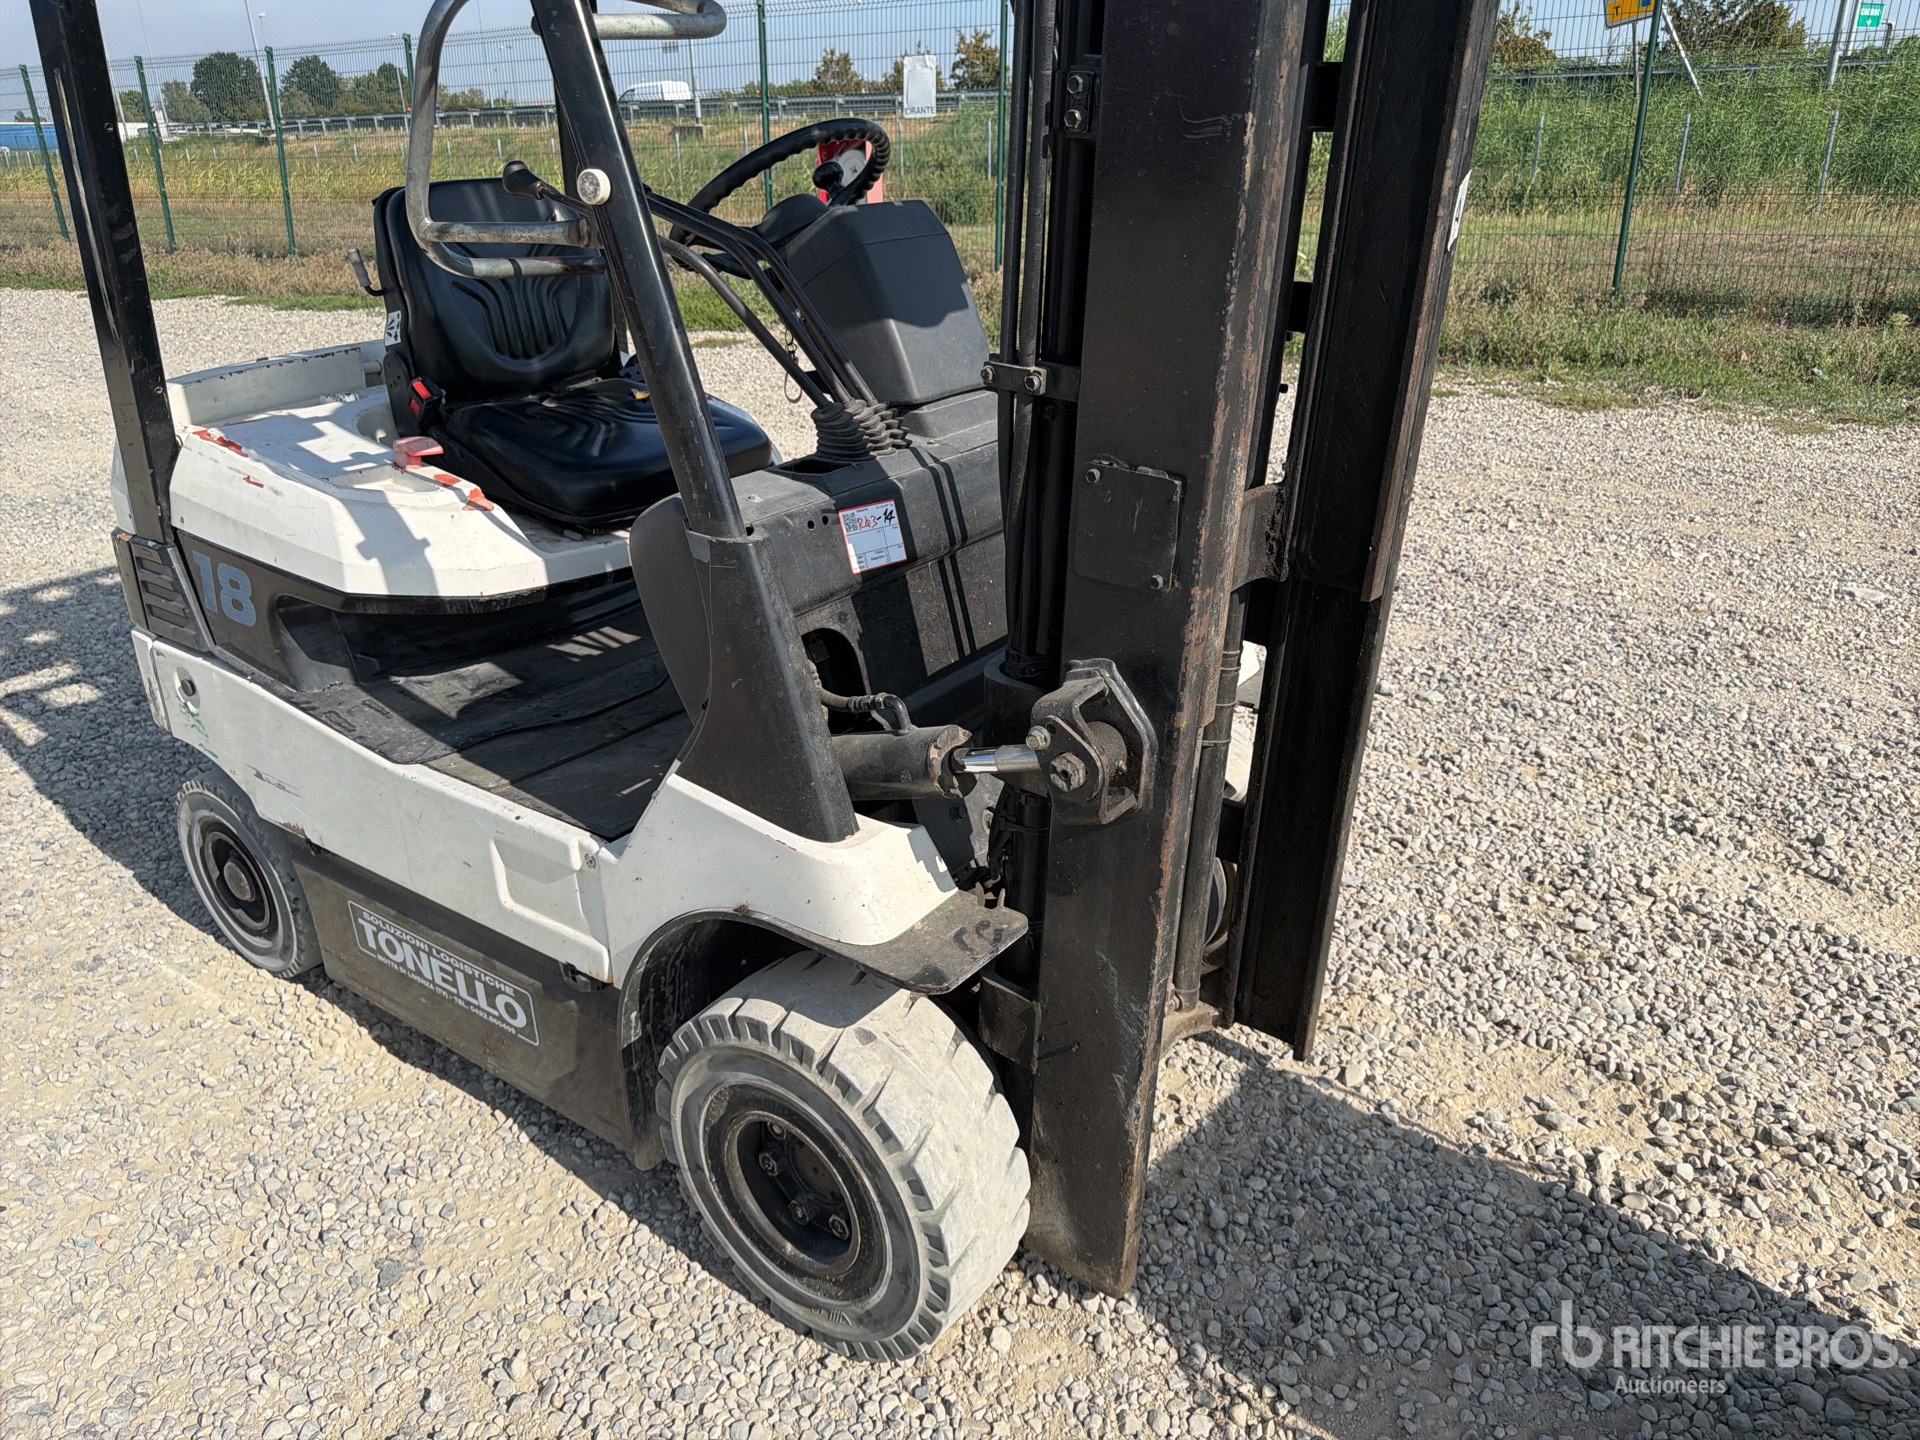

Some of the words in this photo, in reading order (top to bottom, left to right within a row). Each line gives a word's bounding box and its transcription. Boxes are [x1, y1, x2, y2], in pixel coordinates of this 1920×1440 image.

[192, 550, 257, 627] 18
[358, 917, 527, 1028] TONELLO
[362, 911, 429, 952] SOLUZIONI
[432, 947, 515, 997] LOGISTICHE
